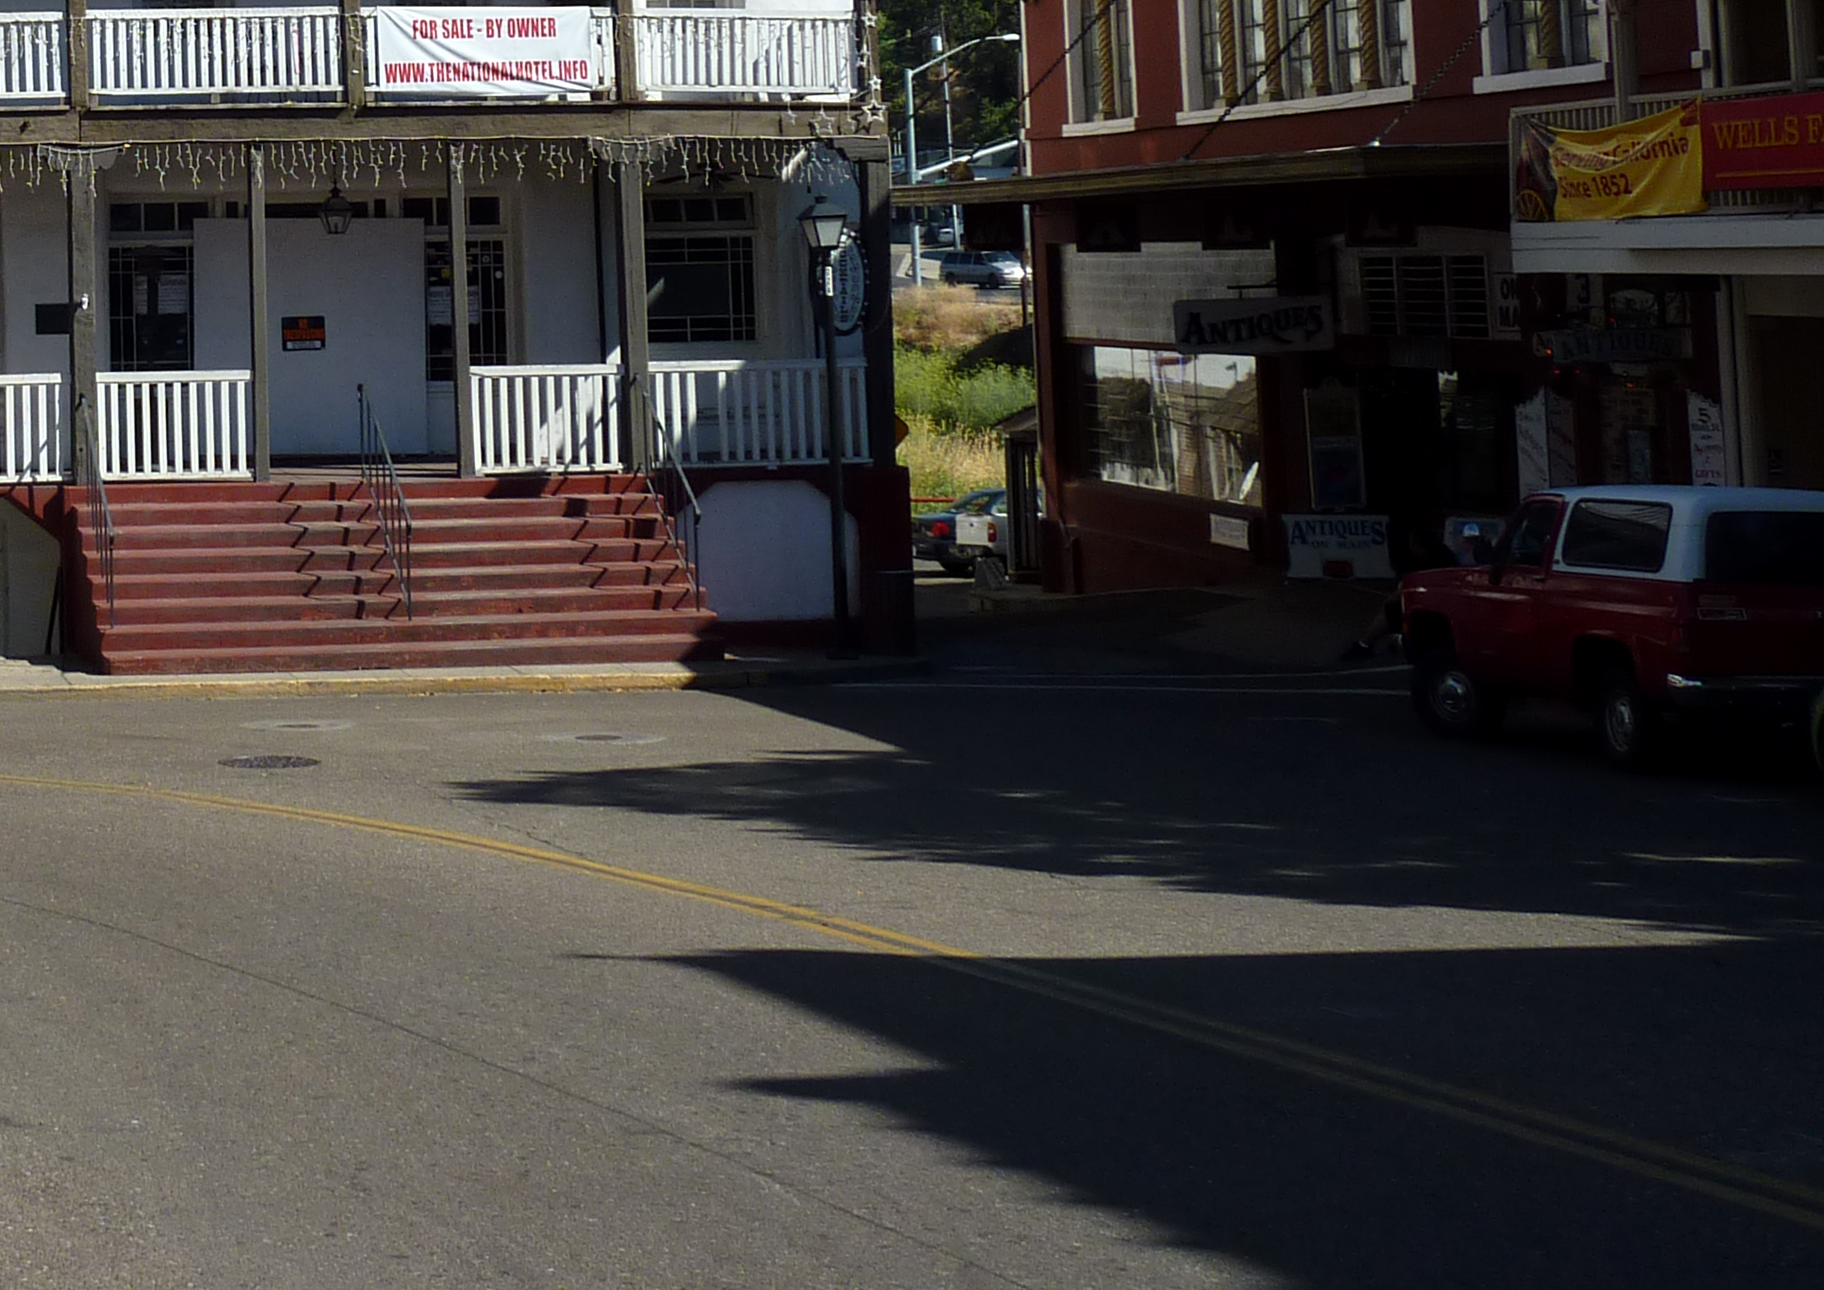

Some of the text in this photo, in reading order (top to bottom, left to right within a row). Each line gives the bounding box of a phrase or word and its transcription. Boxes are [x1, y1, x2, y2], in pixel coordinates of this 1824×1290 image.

[412, 18, 438, 40] FOR
[441, 18, 474, 40] SALE
[485, 18, 502, 39] BY
[507, 17, 557, 39] OWNER
[384, 59, 589, 84] WWW.THENATIONALHOTEL.INFO
[1713, 115, 1801, 150] WELLS
[1613, 132, 1690, 165] Cliornia
[1592, 173, 1633, 198] 1852
[1180, 304, 1323, 345] ANTIQUES
[1290, 519, 1386, 545] ANTIQUES
